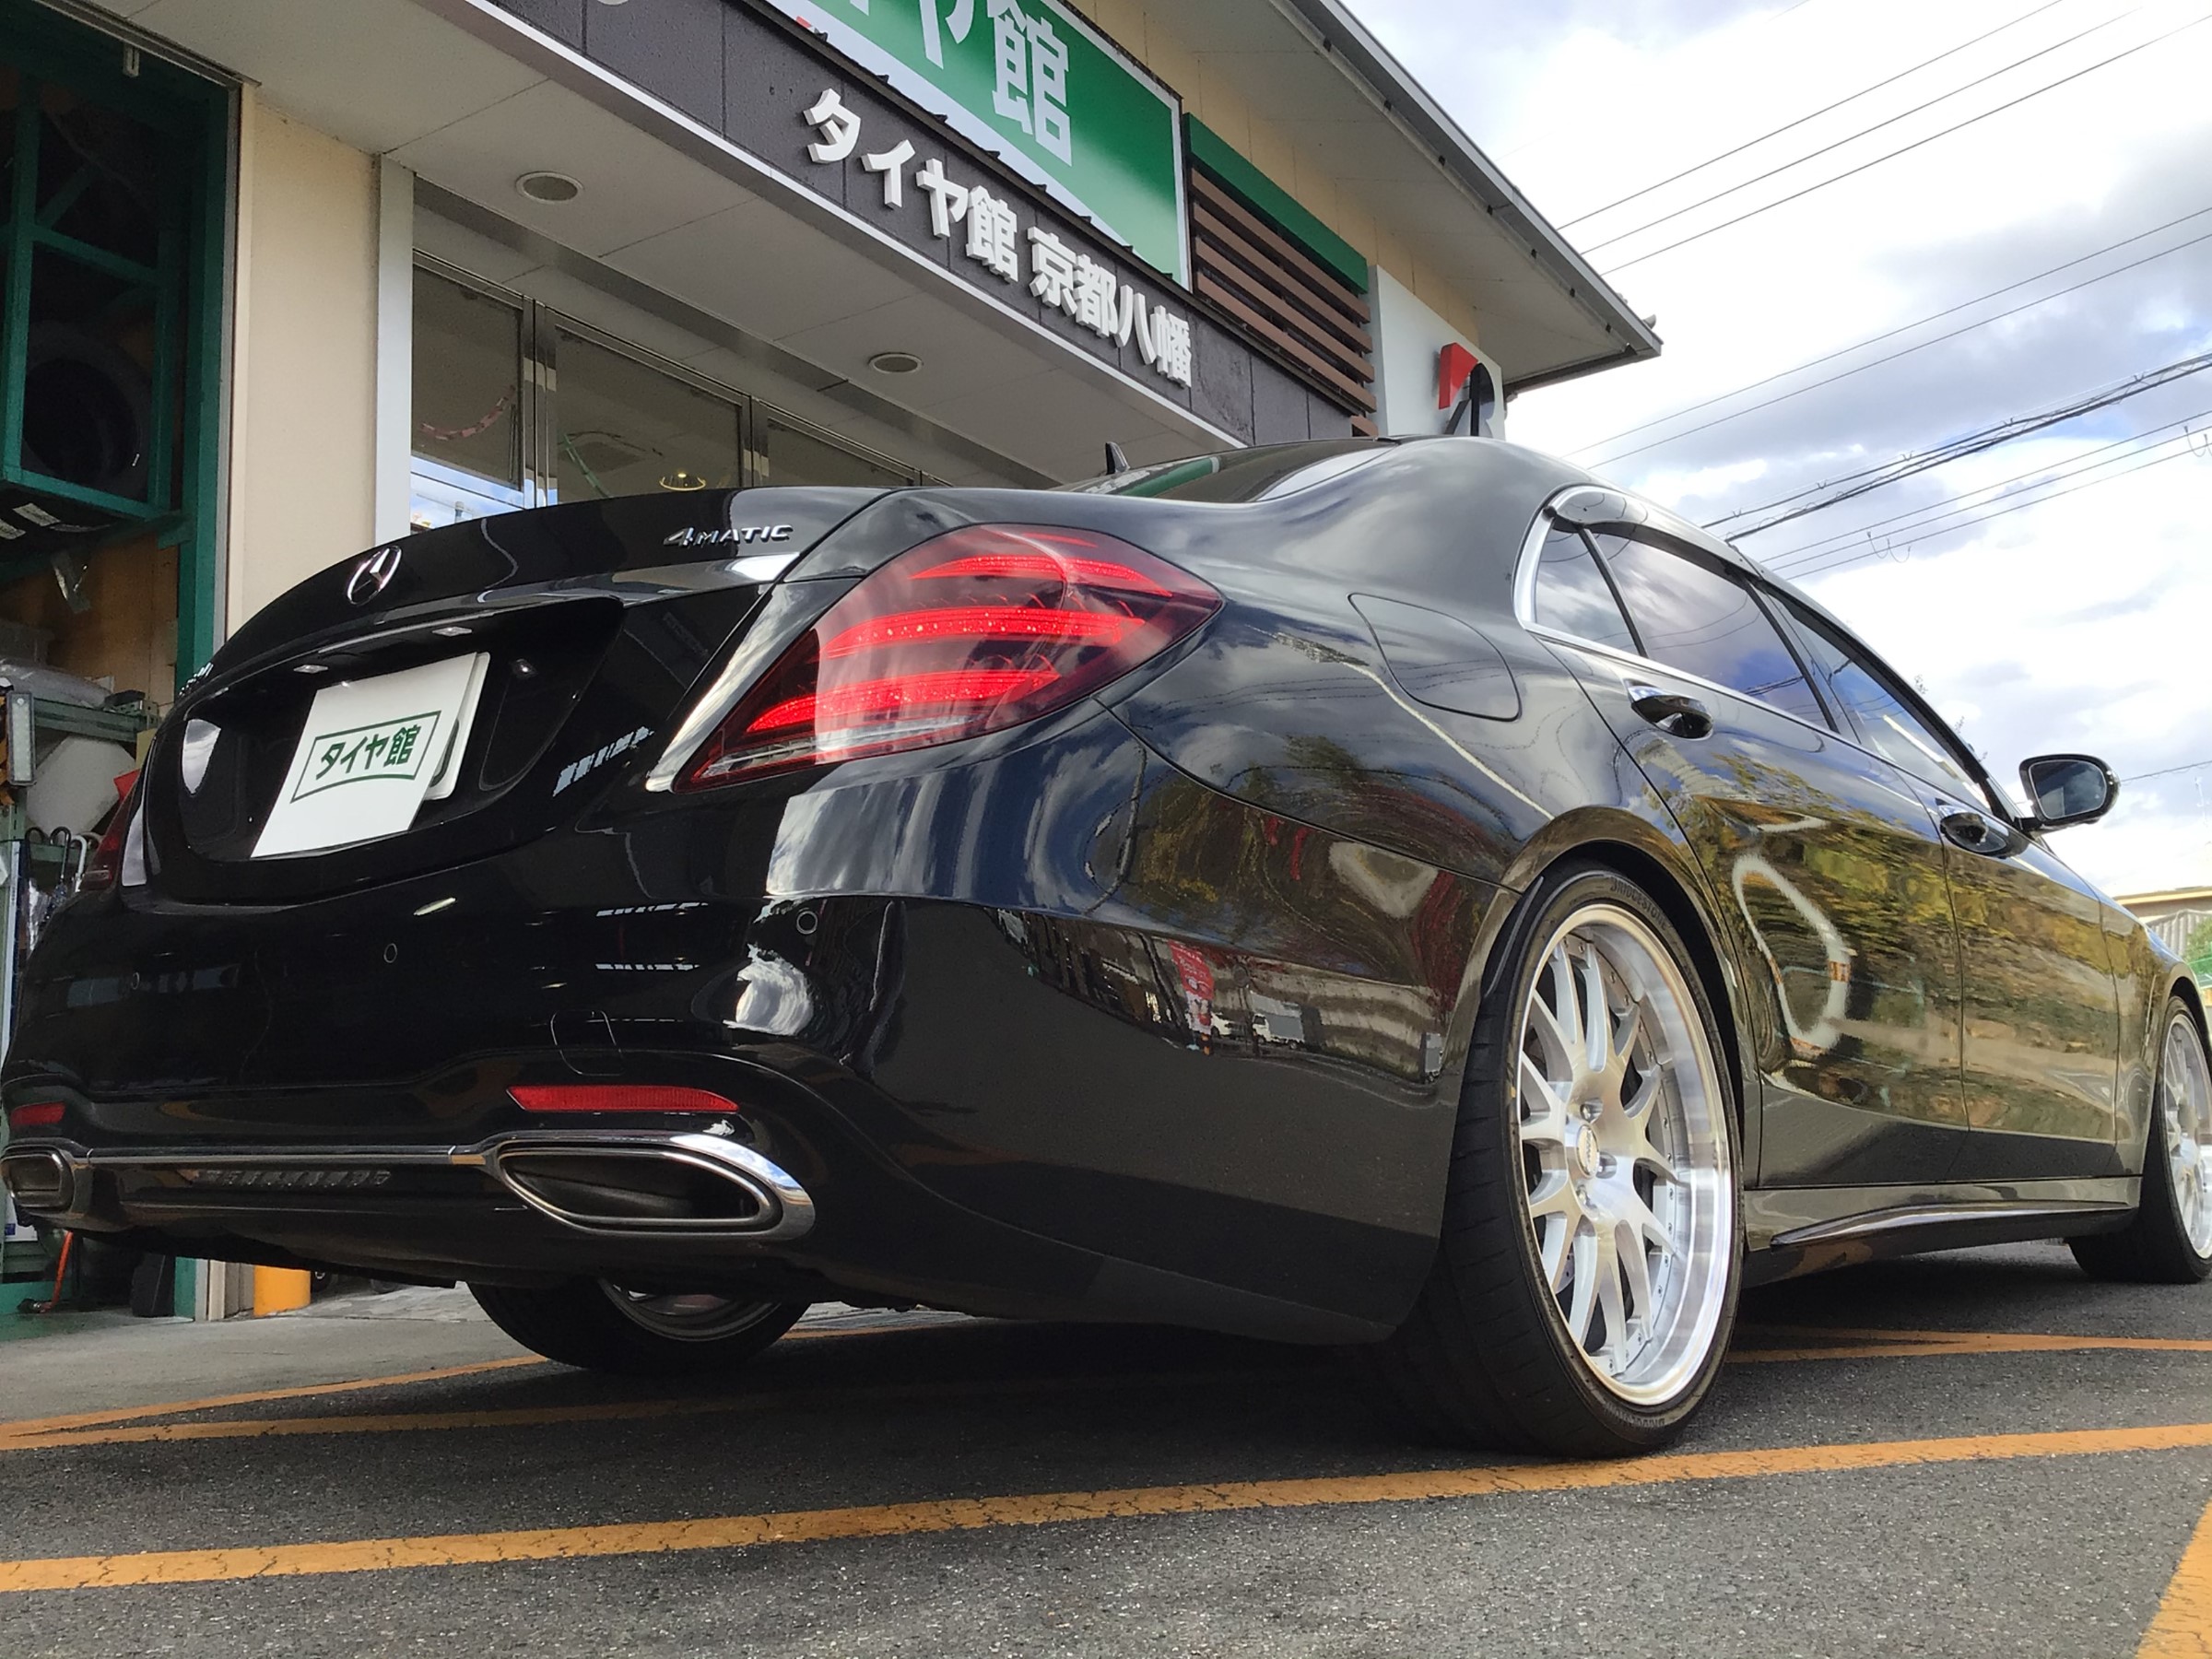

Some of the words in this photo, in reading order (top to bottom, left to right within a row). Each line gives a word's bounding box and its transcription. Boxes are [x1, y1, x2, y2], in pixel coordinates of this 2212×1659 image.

[803, 88, 1019, 283] タイヤ館
[1027, 226, 1192, 388] 京都八幡
[664, 524, 794, 547] 4MATIC
[315, 724, 421, 781] タイヤ館
